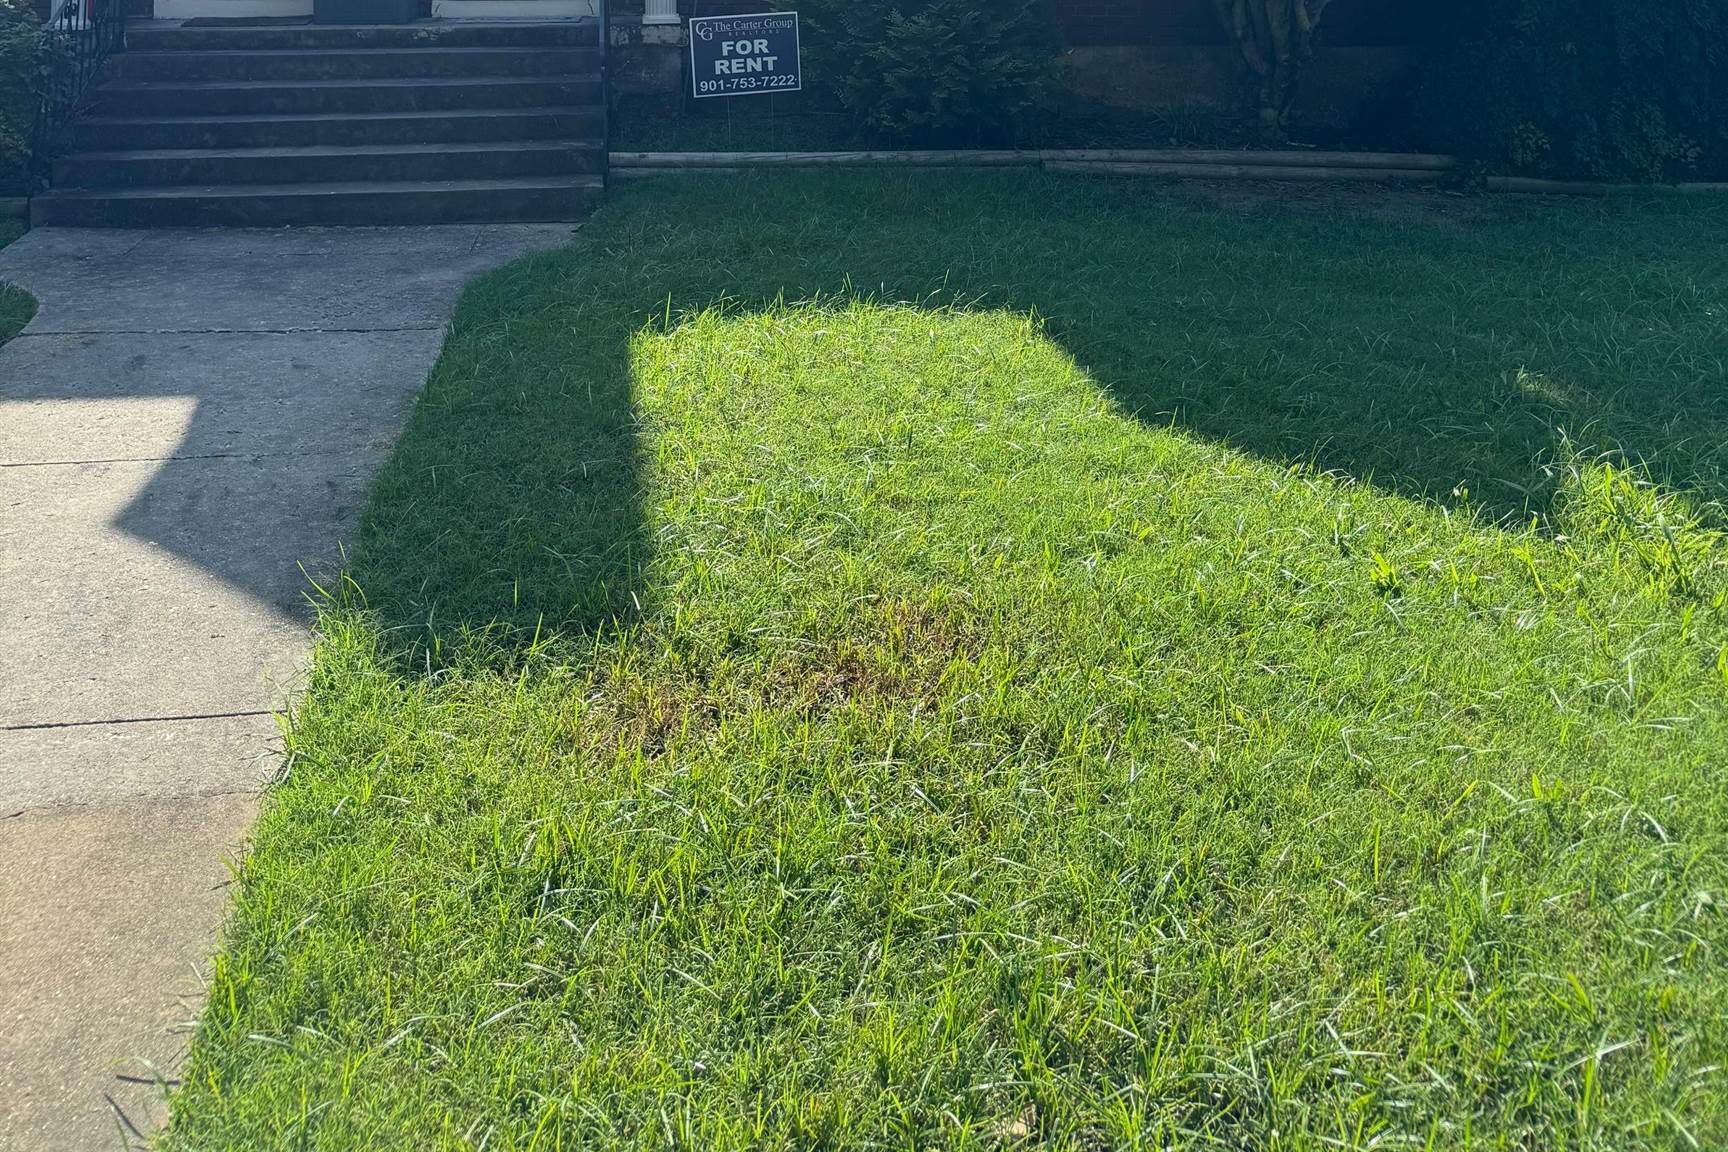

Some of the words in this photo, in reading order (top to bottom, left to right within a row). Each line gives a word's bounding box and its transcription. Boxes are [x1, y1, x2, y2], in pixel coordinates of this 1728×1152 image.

[713, 22, 731, 32] The
[733, 20, 762, 30] Carter
[764, 18, 793, 29] Group
[722, 39, 769, 56] FOR
[714, 56, 778, 74] RENT
[700, 75, 795, 92] 901-753-7222
